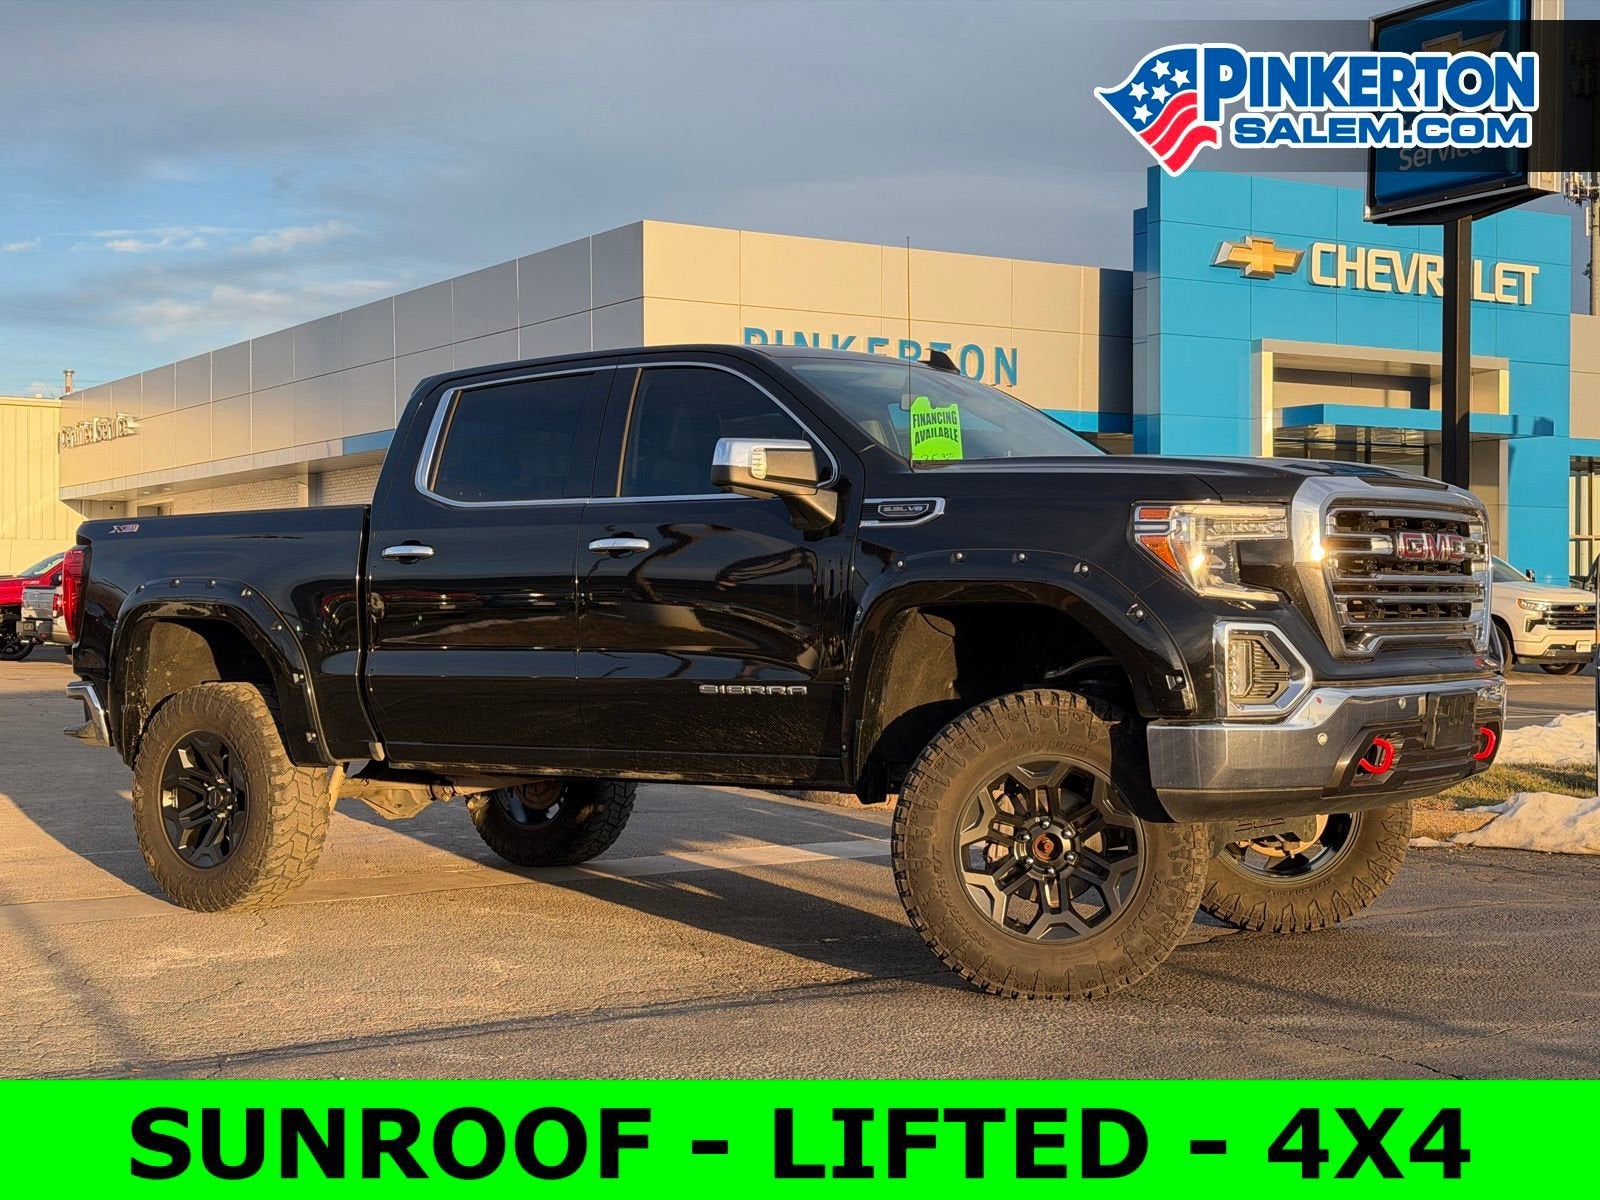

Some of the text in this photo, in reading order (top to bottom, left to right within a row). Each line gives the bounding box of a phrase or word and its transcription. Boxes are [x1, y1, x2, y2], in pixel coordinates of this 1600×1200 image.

[1311, 242, 1540, 305] CHEVRLET
[912, 410, 958, 429] FINANCING
[915, 427, 959, 446] AVAILABLE
[1398, 531, 1466, 561] GMC
[699, 684, 807, 695] SIERRA
